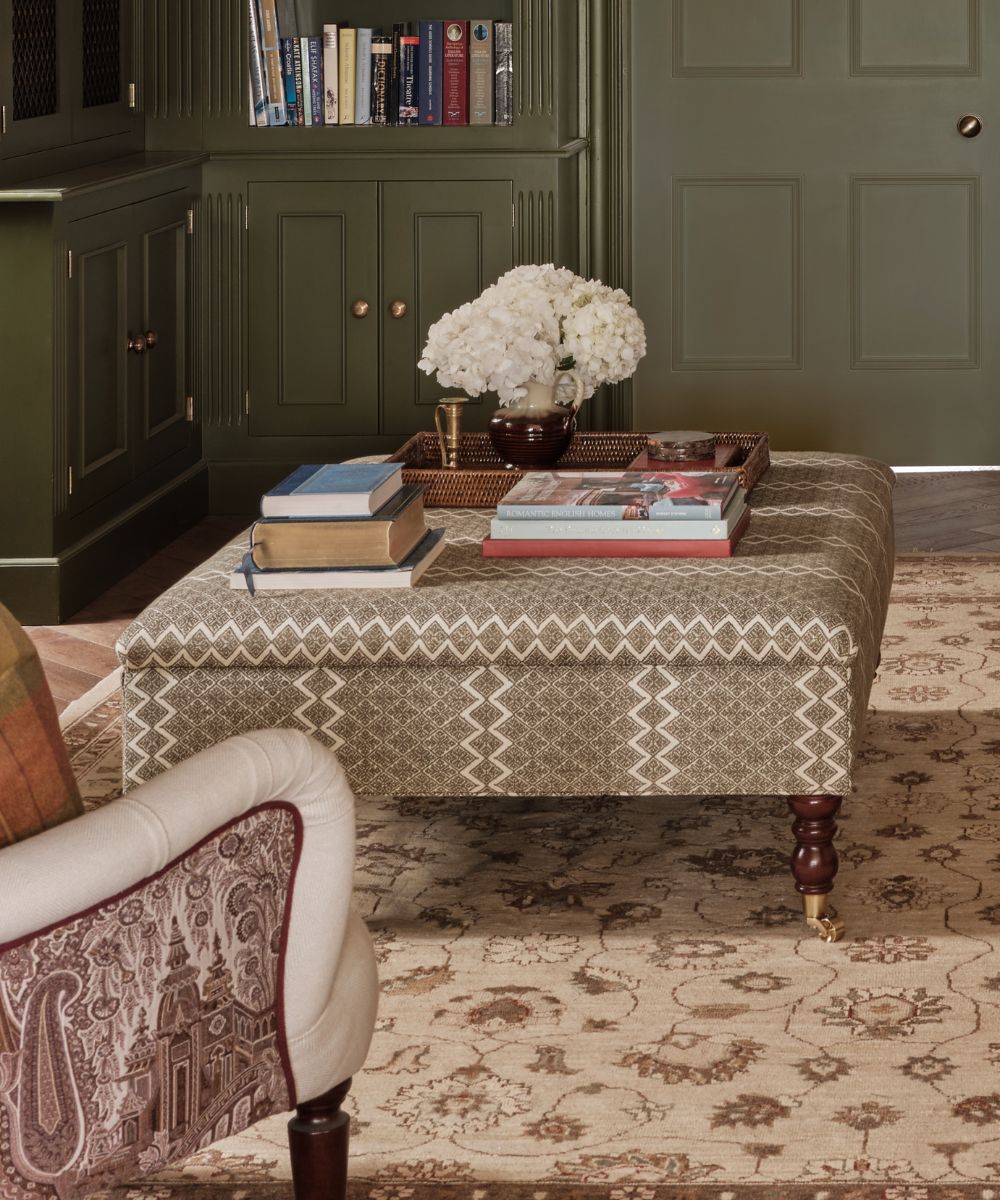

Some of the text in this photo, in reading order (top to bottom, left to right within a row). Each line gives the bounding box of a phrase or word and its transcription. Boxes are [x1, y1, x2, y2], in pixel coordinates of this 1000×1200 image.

[286, 53, 294, 75] Croatia
[294, 44, 304, 90] KATE ATKINSON
[378, 62, 388, 115] DICTIONARY
[406, 74, 414, 106] Theatre
[506, 510, 616, 518] ROMANTIC ENGLISH HOMES
